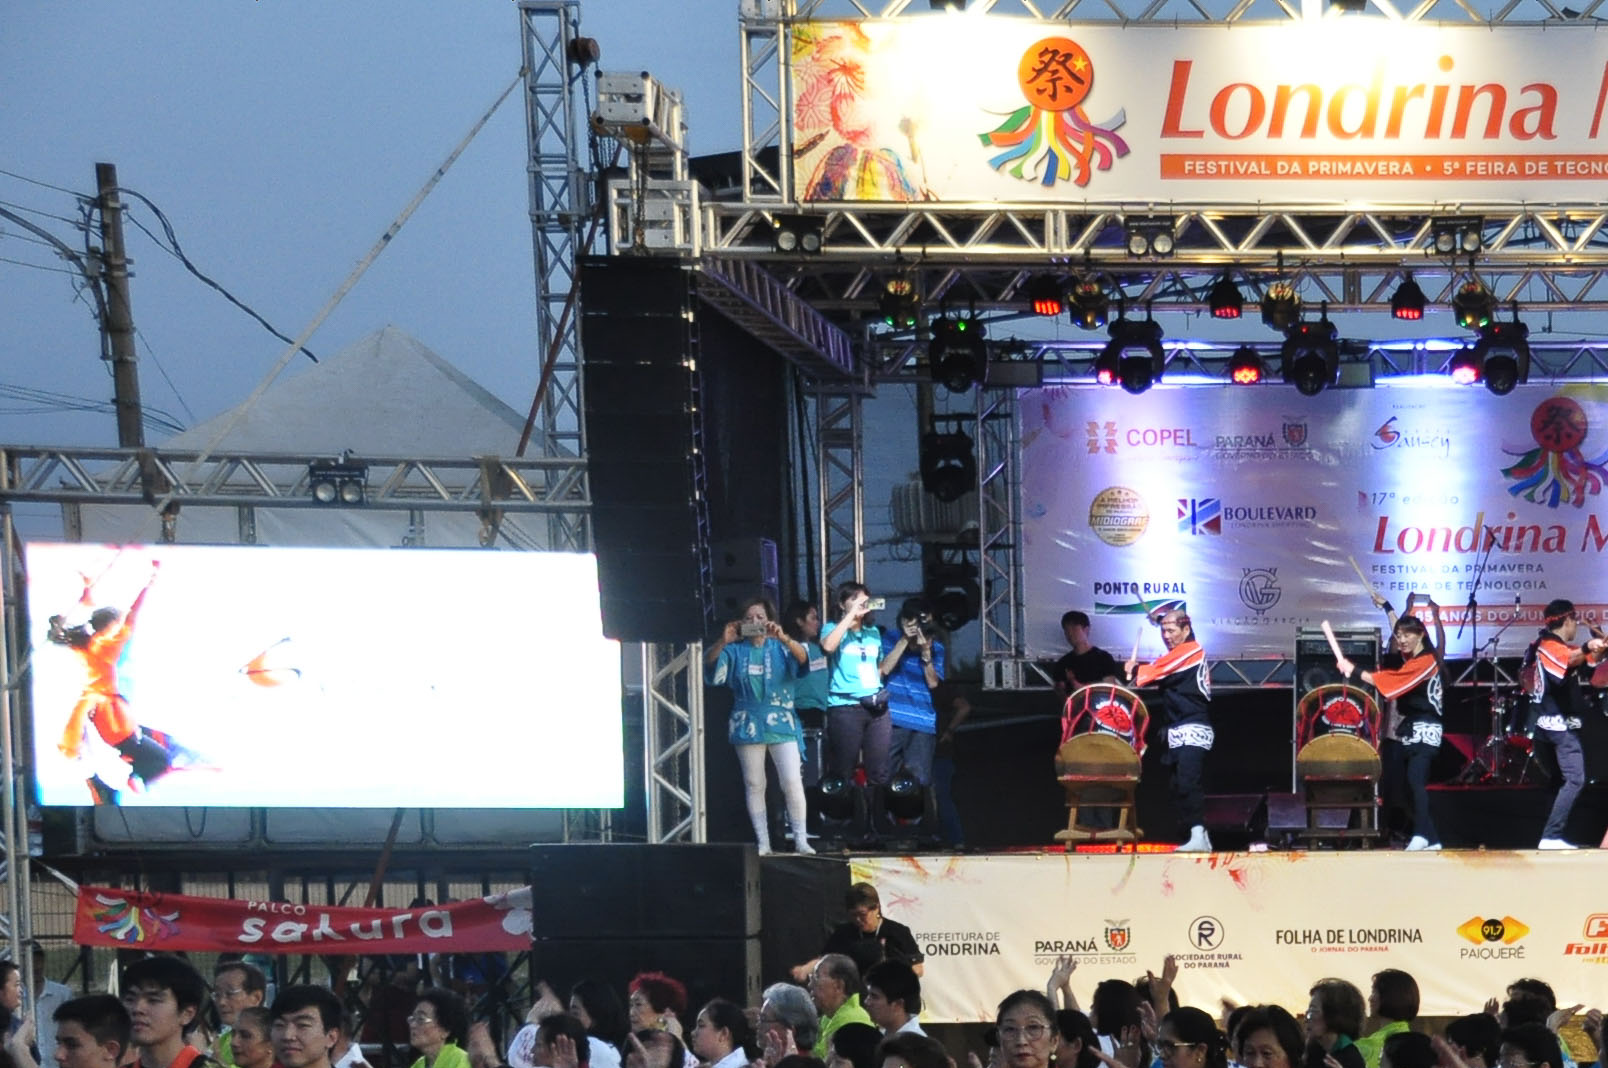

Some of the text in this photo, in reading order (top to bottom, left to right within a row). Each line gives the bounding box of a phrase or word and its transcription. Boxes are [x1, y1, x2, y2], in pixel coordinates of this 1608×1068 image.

[1025, 46, 1086, 102] 祭
[1159, 54, 1559, 141] Londrina
[1184, 160, 1414, 175] FESTIVAL DA PRIMAVERA
[1466, 161, 1519, 175] FEIRA
[1525, 161, 1549, 174] DE
[1126, 428, 1198, 447] COPEL
[1215, 432, 1276, 448] PARANÁ
[1223, 507, 1317, 521] BOULEVARD
[1371, 510, 1567, 555] Londrina
[1465, 563, 1544, 574] PRIMAVERA
[1093, 582, 1187, 595] PONTO RURAL
[1457, 580, 1547, 591] TECNOLOGIA
[1439, 610, 1482, 622] ANOS
[1487, 610, 1509, 622] DO
[247, 900, 307, 915] PALCO
[237, 909, 453, 944] sakura
[916, 931, 1000, 942] PREFEITURA DE
[1275, 928, 1423, 945] FOLHA DE LONDRINA
[925, 942, 1000, 956] ONDRINA
[1034, 937, 1098, 953] PARANÁ
[1460, 945, 1526, 960] PAIQUERÊ
[1083, 956, 1098, 965] DO
[1100, 956, 1136, 965] ESTADO
[1184, 960, 1230, 969] DO PARANÁ
